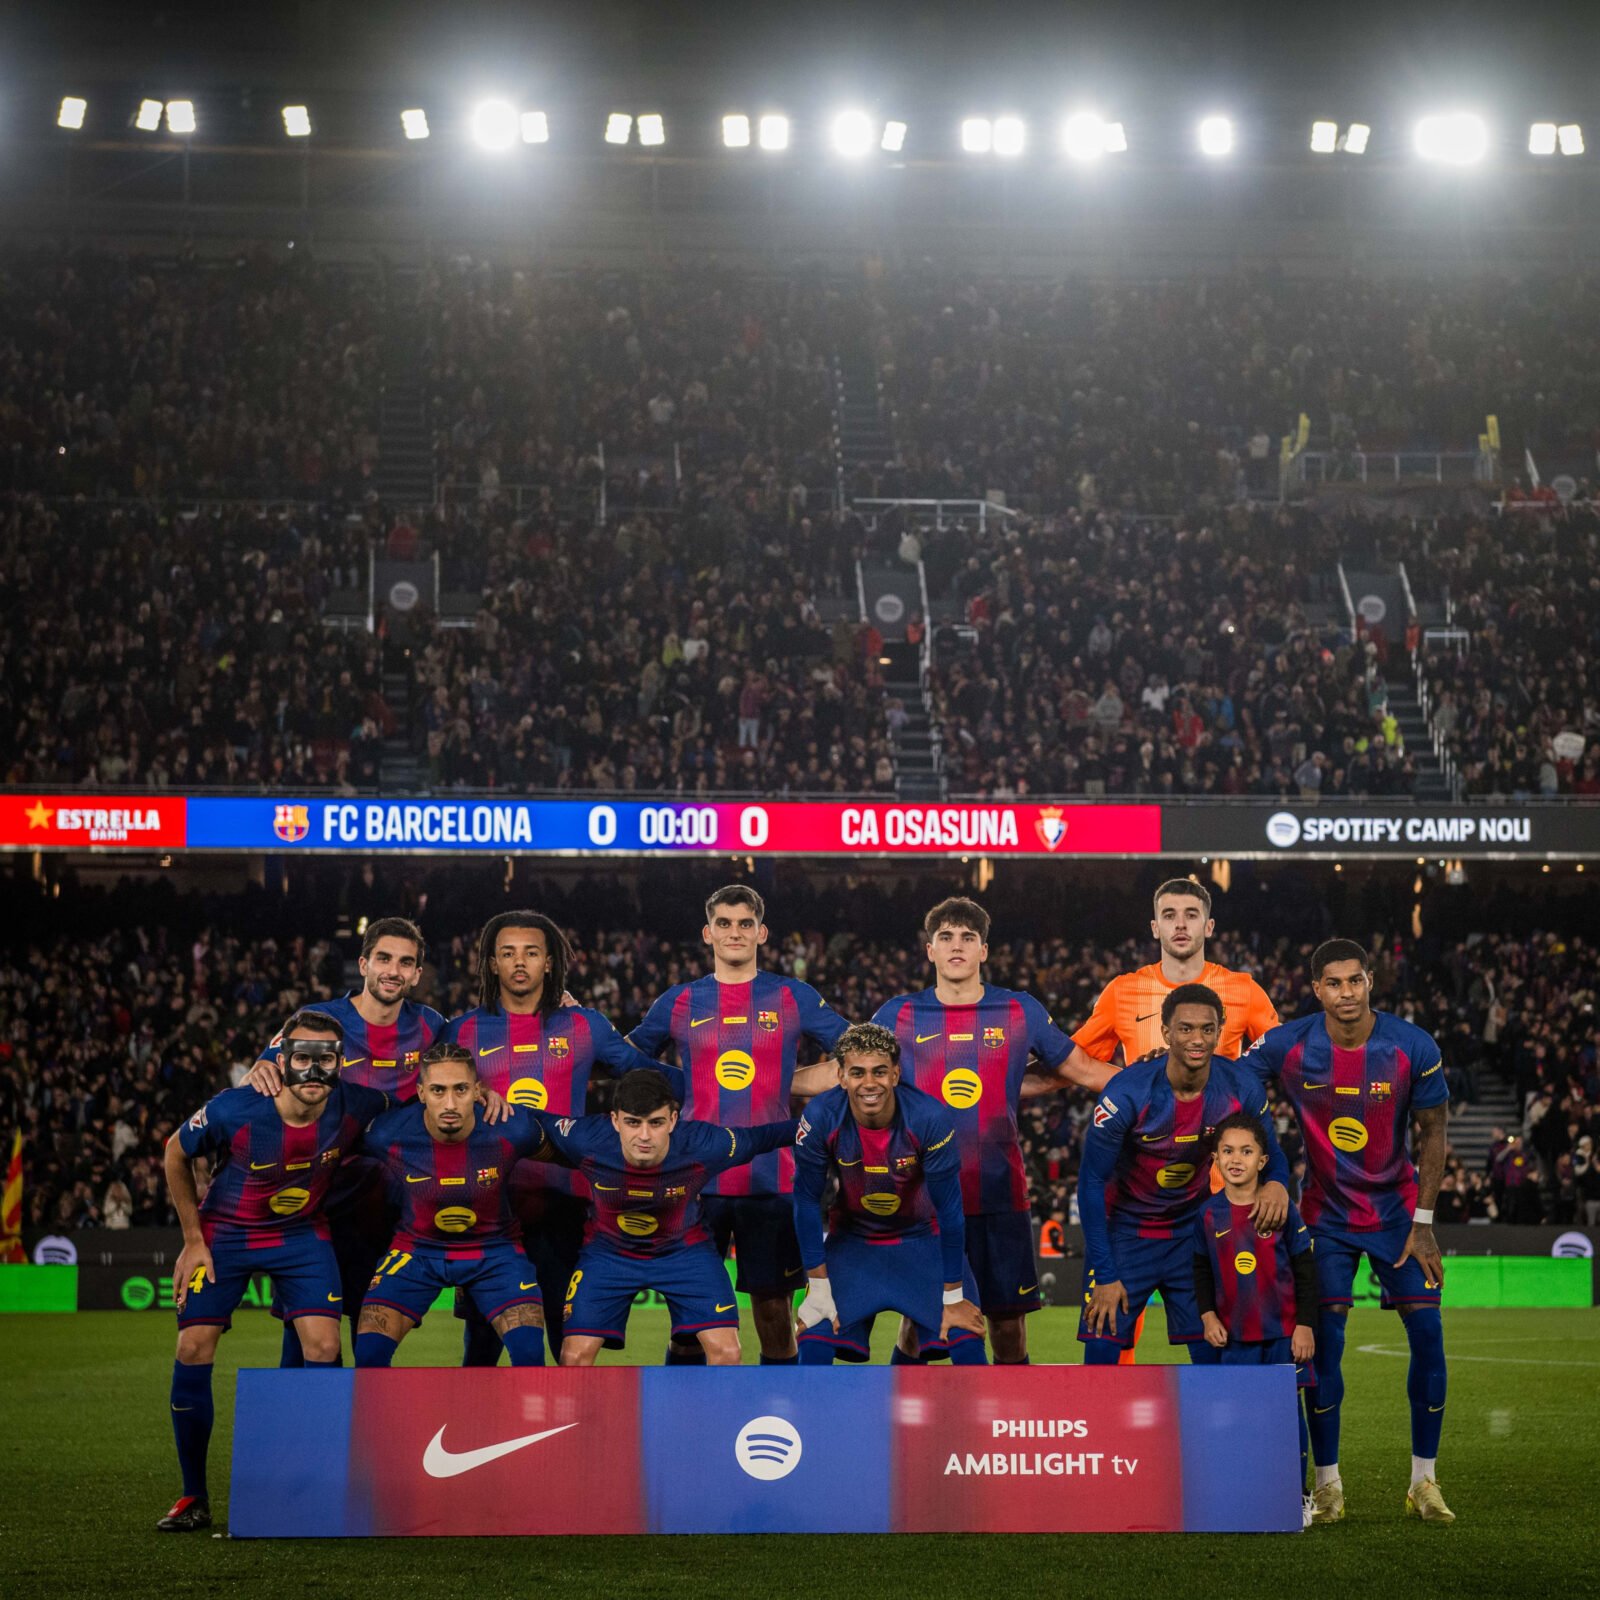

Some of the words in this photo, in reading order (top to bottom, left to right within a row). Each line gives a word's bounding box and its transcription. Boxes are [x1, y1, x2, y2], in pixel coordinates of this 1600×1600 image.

[56, 808, 161, 830] ESTRELLA
[324, 805, 358, 842] FC
[365, 805, 532, 843] BARCELONA
[588, 805, 617, 845] 0
[639, 807, 718, 845] 00:00
[740, 806, 769, 847] 0
[841, 808, 879, 845] CA
[885, 809, 1019, 846] OSASUNA
[1302, 817, 1403, 842] SPOTIFY
[1405, 818, 1475, 842] CAMP
[1479, 818, 1531, 842] NOU
[376, 1249, 413, 1275] 11
[565, 1270, 583, 1301] 8
[992, 1419, 1089, 1438] PHILIPS
[943, 1453, 1105, 1475] AMBILIGHT
[1111, 1455, 1139, 1475] tv
